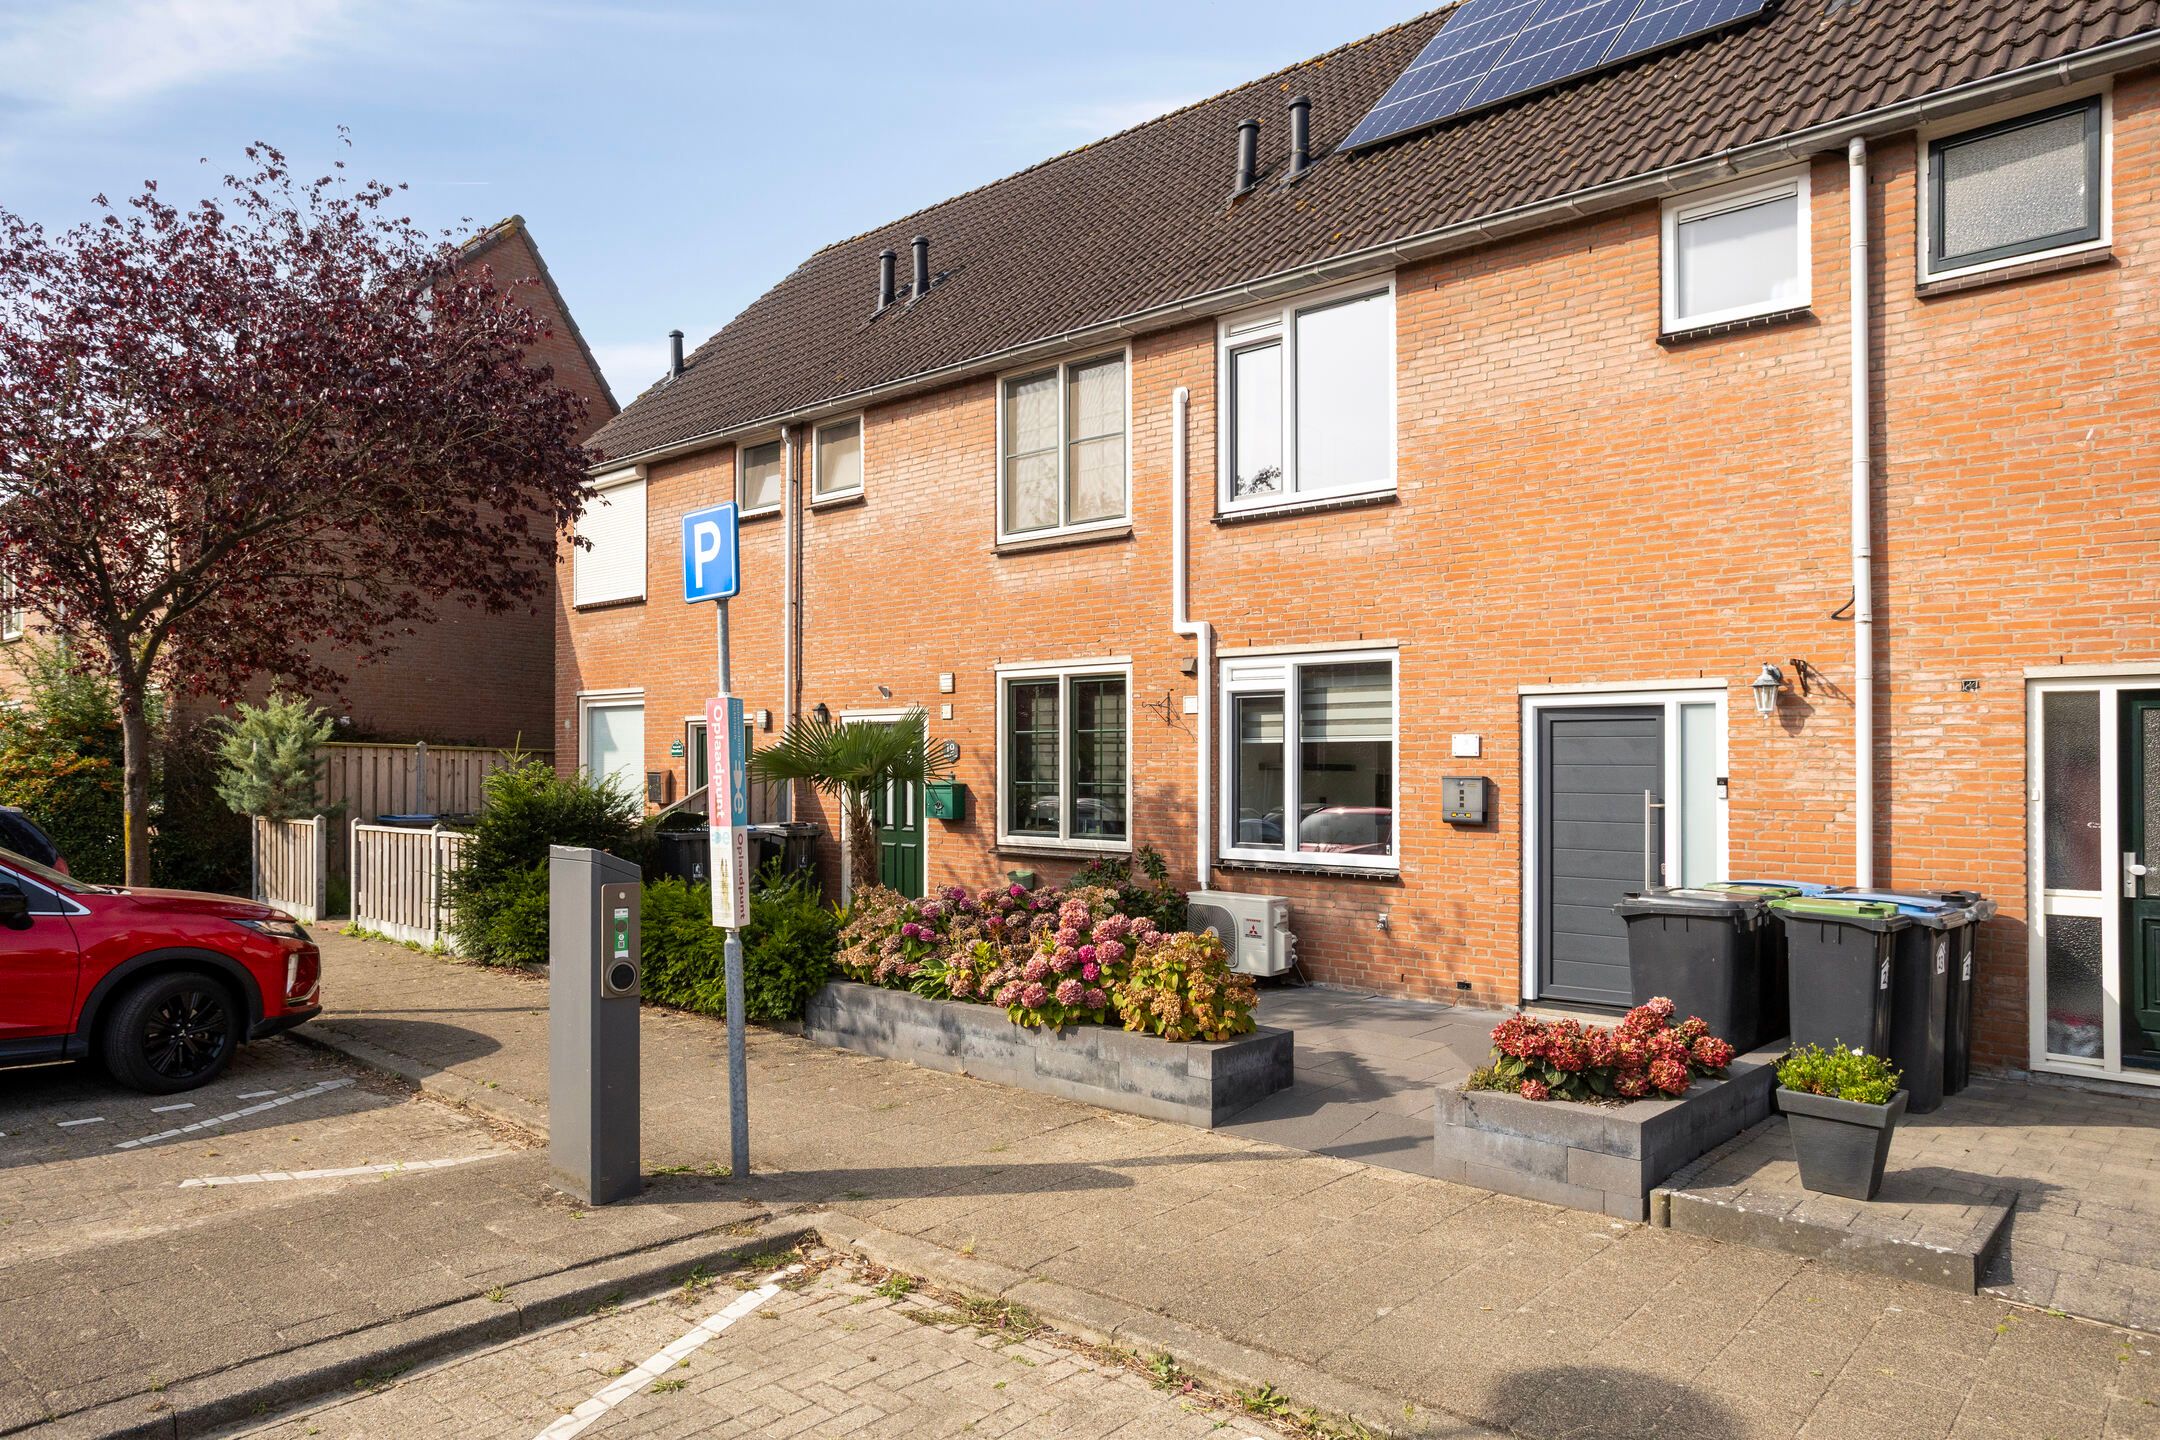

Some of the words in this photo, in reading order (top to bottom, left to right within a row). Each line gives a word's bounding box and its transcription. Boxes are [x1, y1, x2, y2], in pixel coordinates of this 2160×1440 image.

[694, 521, 721, 588] P
[712, 704, 725, 818] Oplaadpunt
[736, 833, 745, 919] Oplaadpunt
